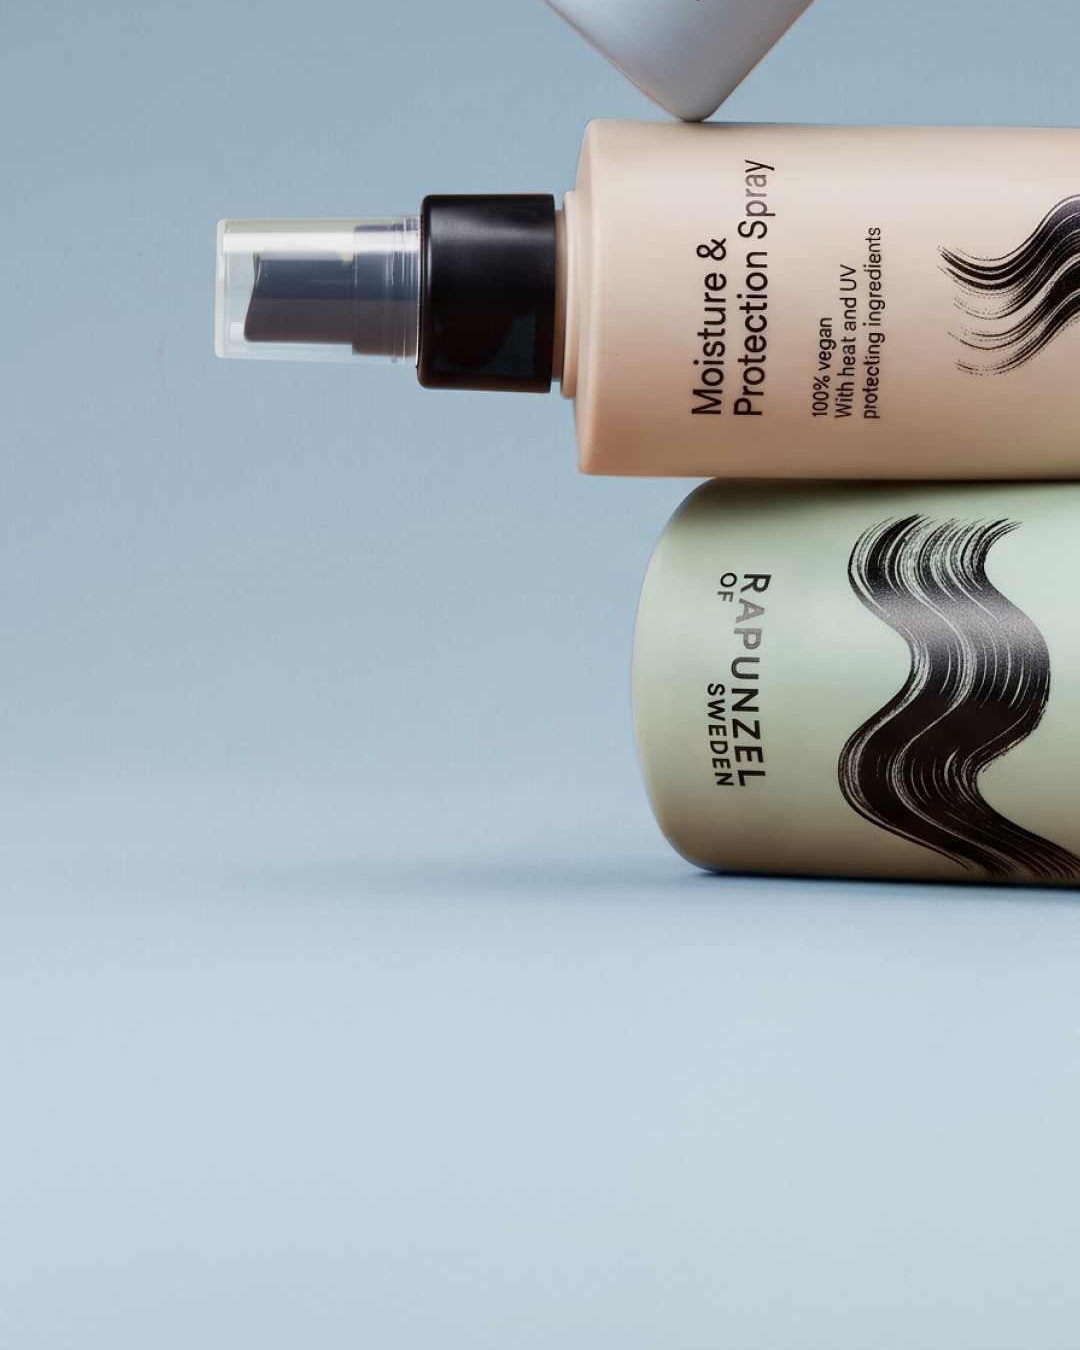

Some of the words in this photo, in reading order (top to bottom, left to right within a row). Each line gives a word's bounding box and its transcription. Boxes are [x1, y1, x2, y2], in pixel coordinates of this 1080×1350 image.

[737, 159, 776, 240] Spray
[696, 238, 727, 261] &
[863, 227, 886, 326] ingredients
[839, 264, 857, 292] UV
[733, 251, 768, 416] Protection
[839, 296, 857, 332] and
[691, 272, 727, 415] Moisture
[818, 317, 837, 372] vegan
[839, 337, 856, 377] heat
[812, 376, 831, 417] 100%
[835, 381, 854, 418] With
[863, 331, 885, 419] protecting
[717, 572, 737, 602] OF
[731, 573, 772, 786] RAPUNZEL
[707, 683, 735, 786] SWEDEN
